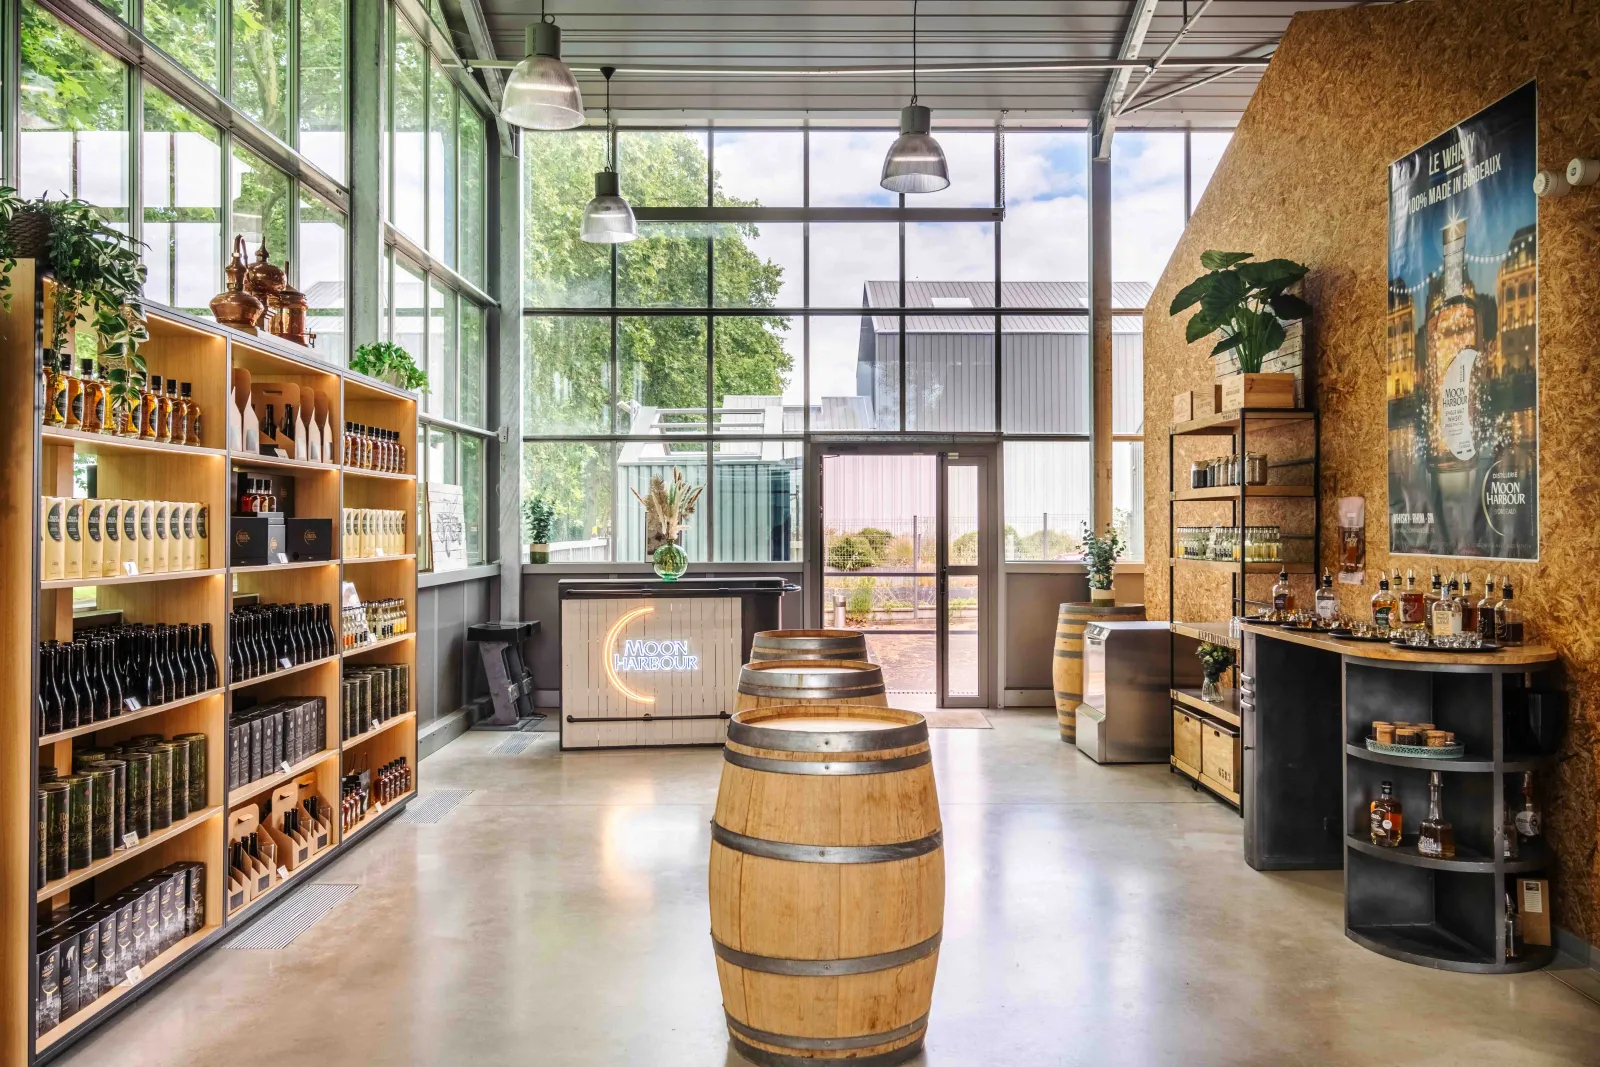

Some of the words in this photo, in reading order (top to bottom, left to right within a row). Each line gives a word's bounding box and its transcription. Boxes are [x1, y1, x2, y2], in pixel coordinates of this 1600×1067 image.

[1429, 152, 1440, 175] LE
[1442, 132, 1475, 169] WHISKY
[1408, 192, 1428, 214] 100%
[1428, 180, 1452, 206] MADE
[1453, 176, 1461, 194] IN
[1462, 152, 1501, 190] BORDEAUX
[1445, 387, 1465, 398] MOON
[1443, 396, 1467, 408] HARBOUR
[1491, 481, 1520, 494] MOON
[1486, 492, 1525, 505] HARBOUR
[1392, 513, 1410, 524] WHISKY
[624, 640, 688, 657] MOON
[614, 654, 698, 671] HARBOUR
